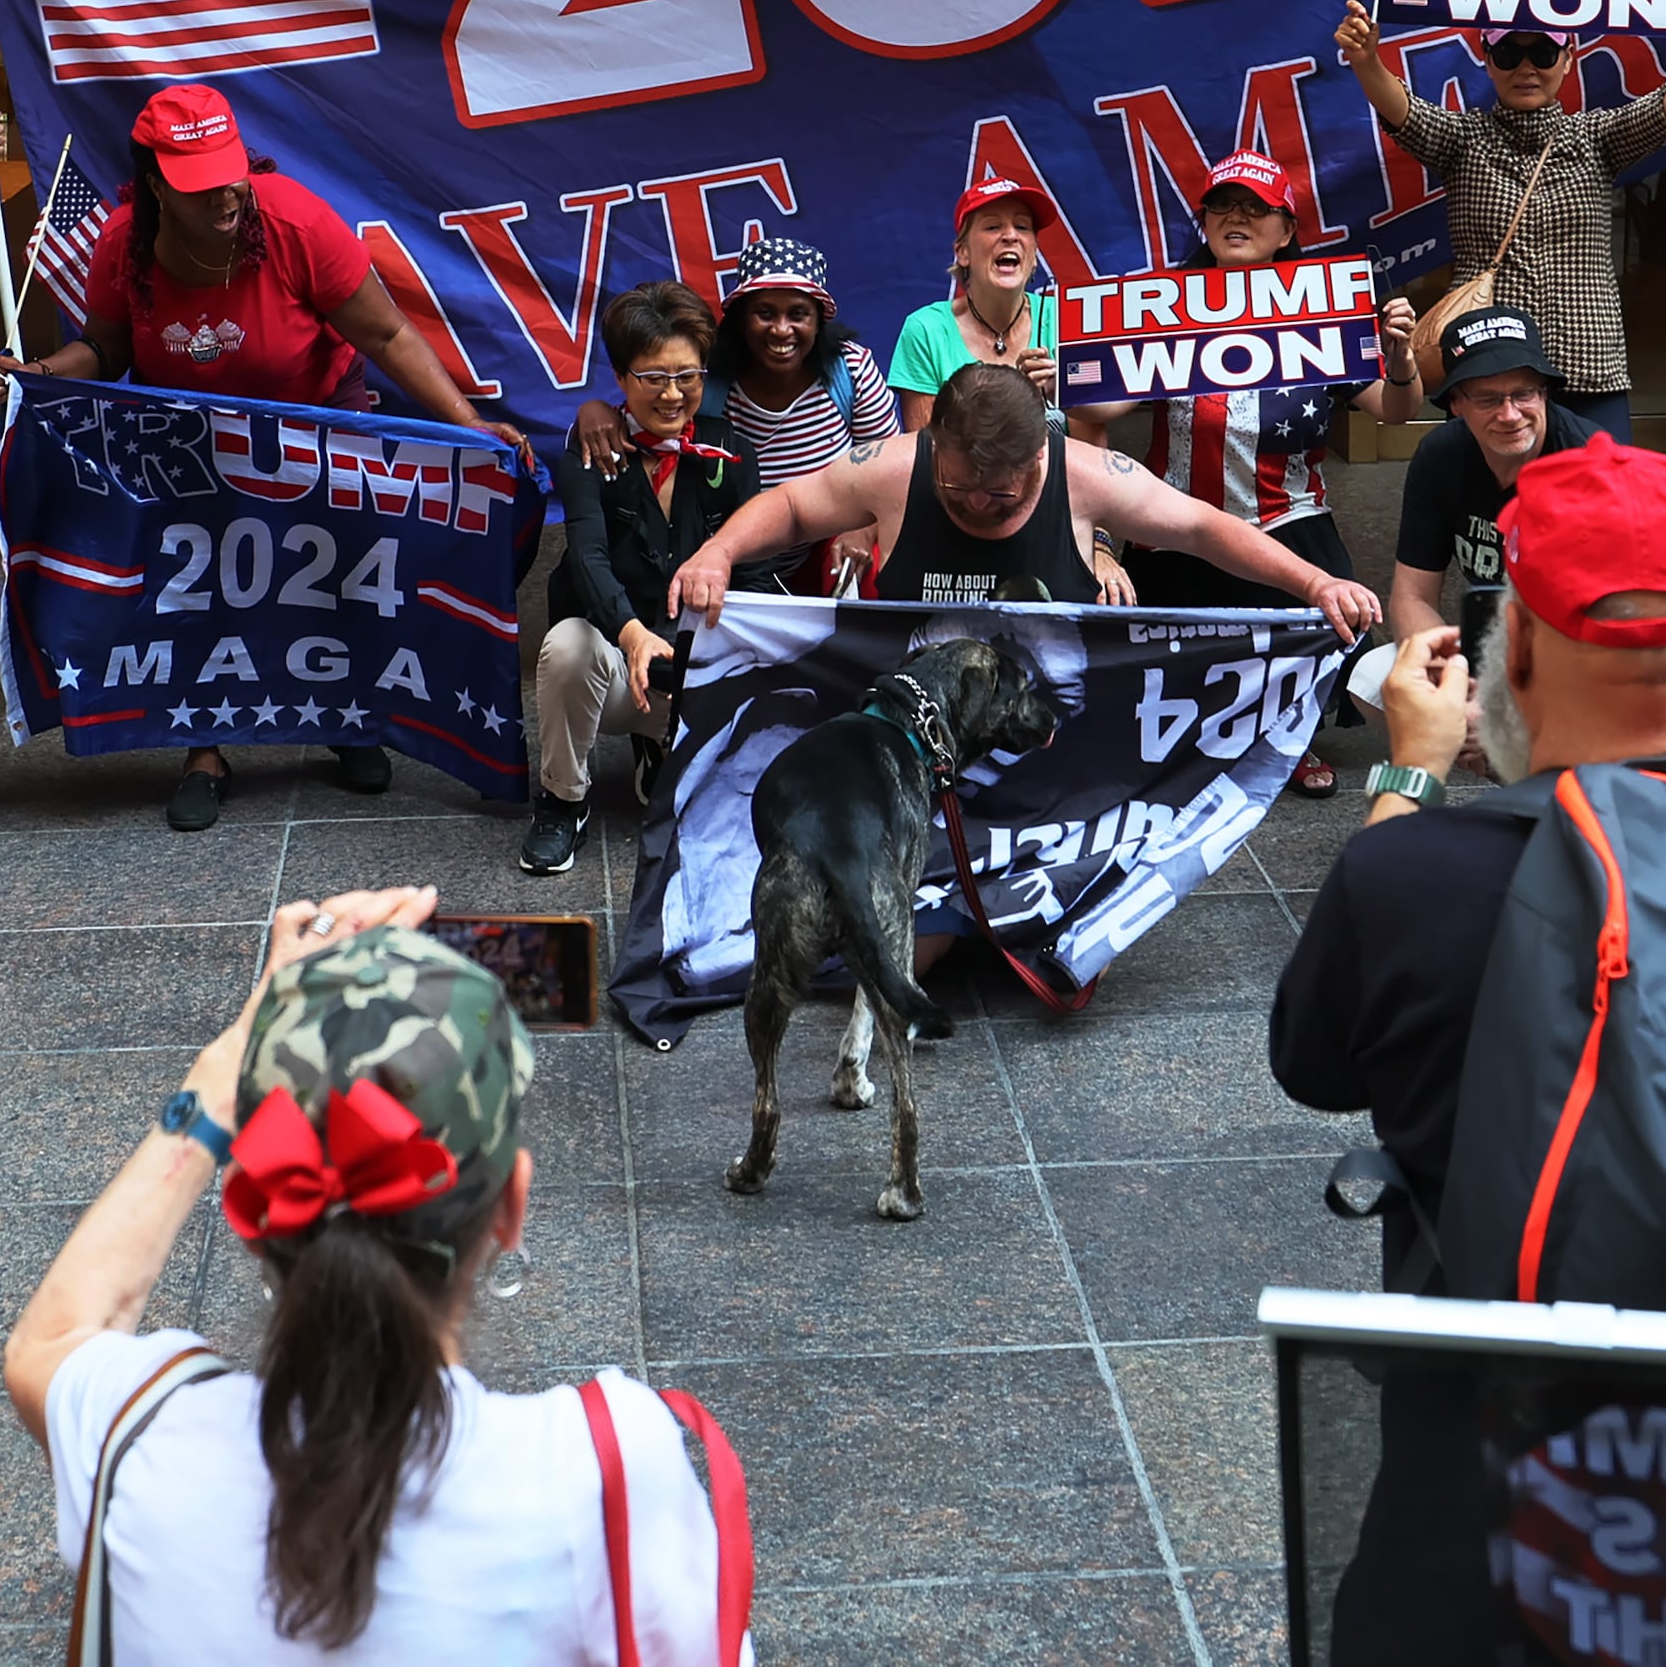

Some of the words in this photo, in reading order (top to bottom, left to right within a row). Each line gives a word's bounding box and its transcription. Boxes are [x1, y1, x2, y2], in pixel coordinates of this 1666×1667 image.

[1237, 152, 1282, 175] AMERICA
[1241, 167, 1275, 186] AGAIN
[357, 156, 799, 400] AVE
[1457, 320, 1486, 339] MAKE
[1464, 329, 1496, 347] GREAT
[1111, 327, 1346, 395] WON
[1468, 514, 1497, 545] THIS
[156, 517, 404, 619] 2024
[923, 572, 953, 589] HOW
[955, 575, 997, 590] ABOUT
[102, 635, 432, 703] MAGA
